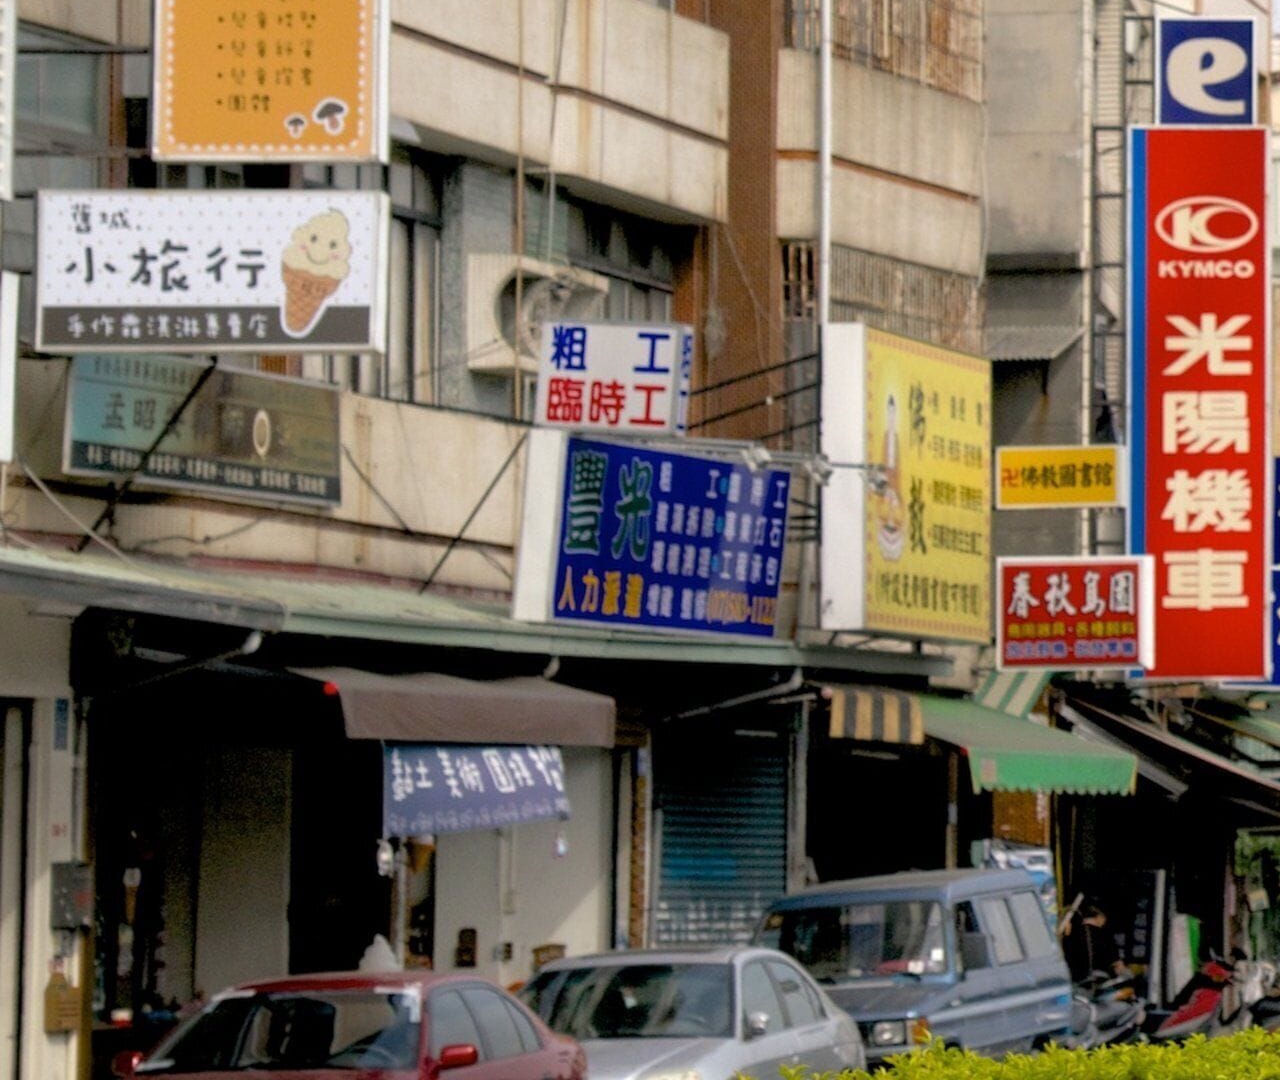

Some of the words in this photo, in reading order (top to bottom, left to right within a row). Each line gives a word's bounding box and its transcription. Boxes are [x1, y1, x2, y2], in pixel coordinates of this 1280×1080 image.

[65, 239, 266, 292] 小旅行
[1158, 259, 1256, 279] KYMCO
[67, 313, 268, 339] 手作霜淇淋專賣店
[547, 377, 666, 427] 臨時工
[1161, 313, 1253, 611] 光陽機車
[1007, 570, 1136, 619] 春秋鳥園
[391, 748, 433, 801] 黏土
[436, 748, 485, 798] 美術
